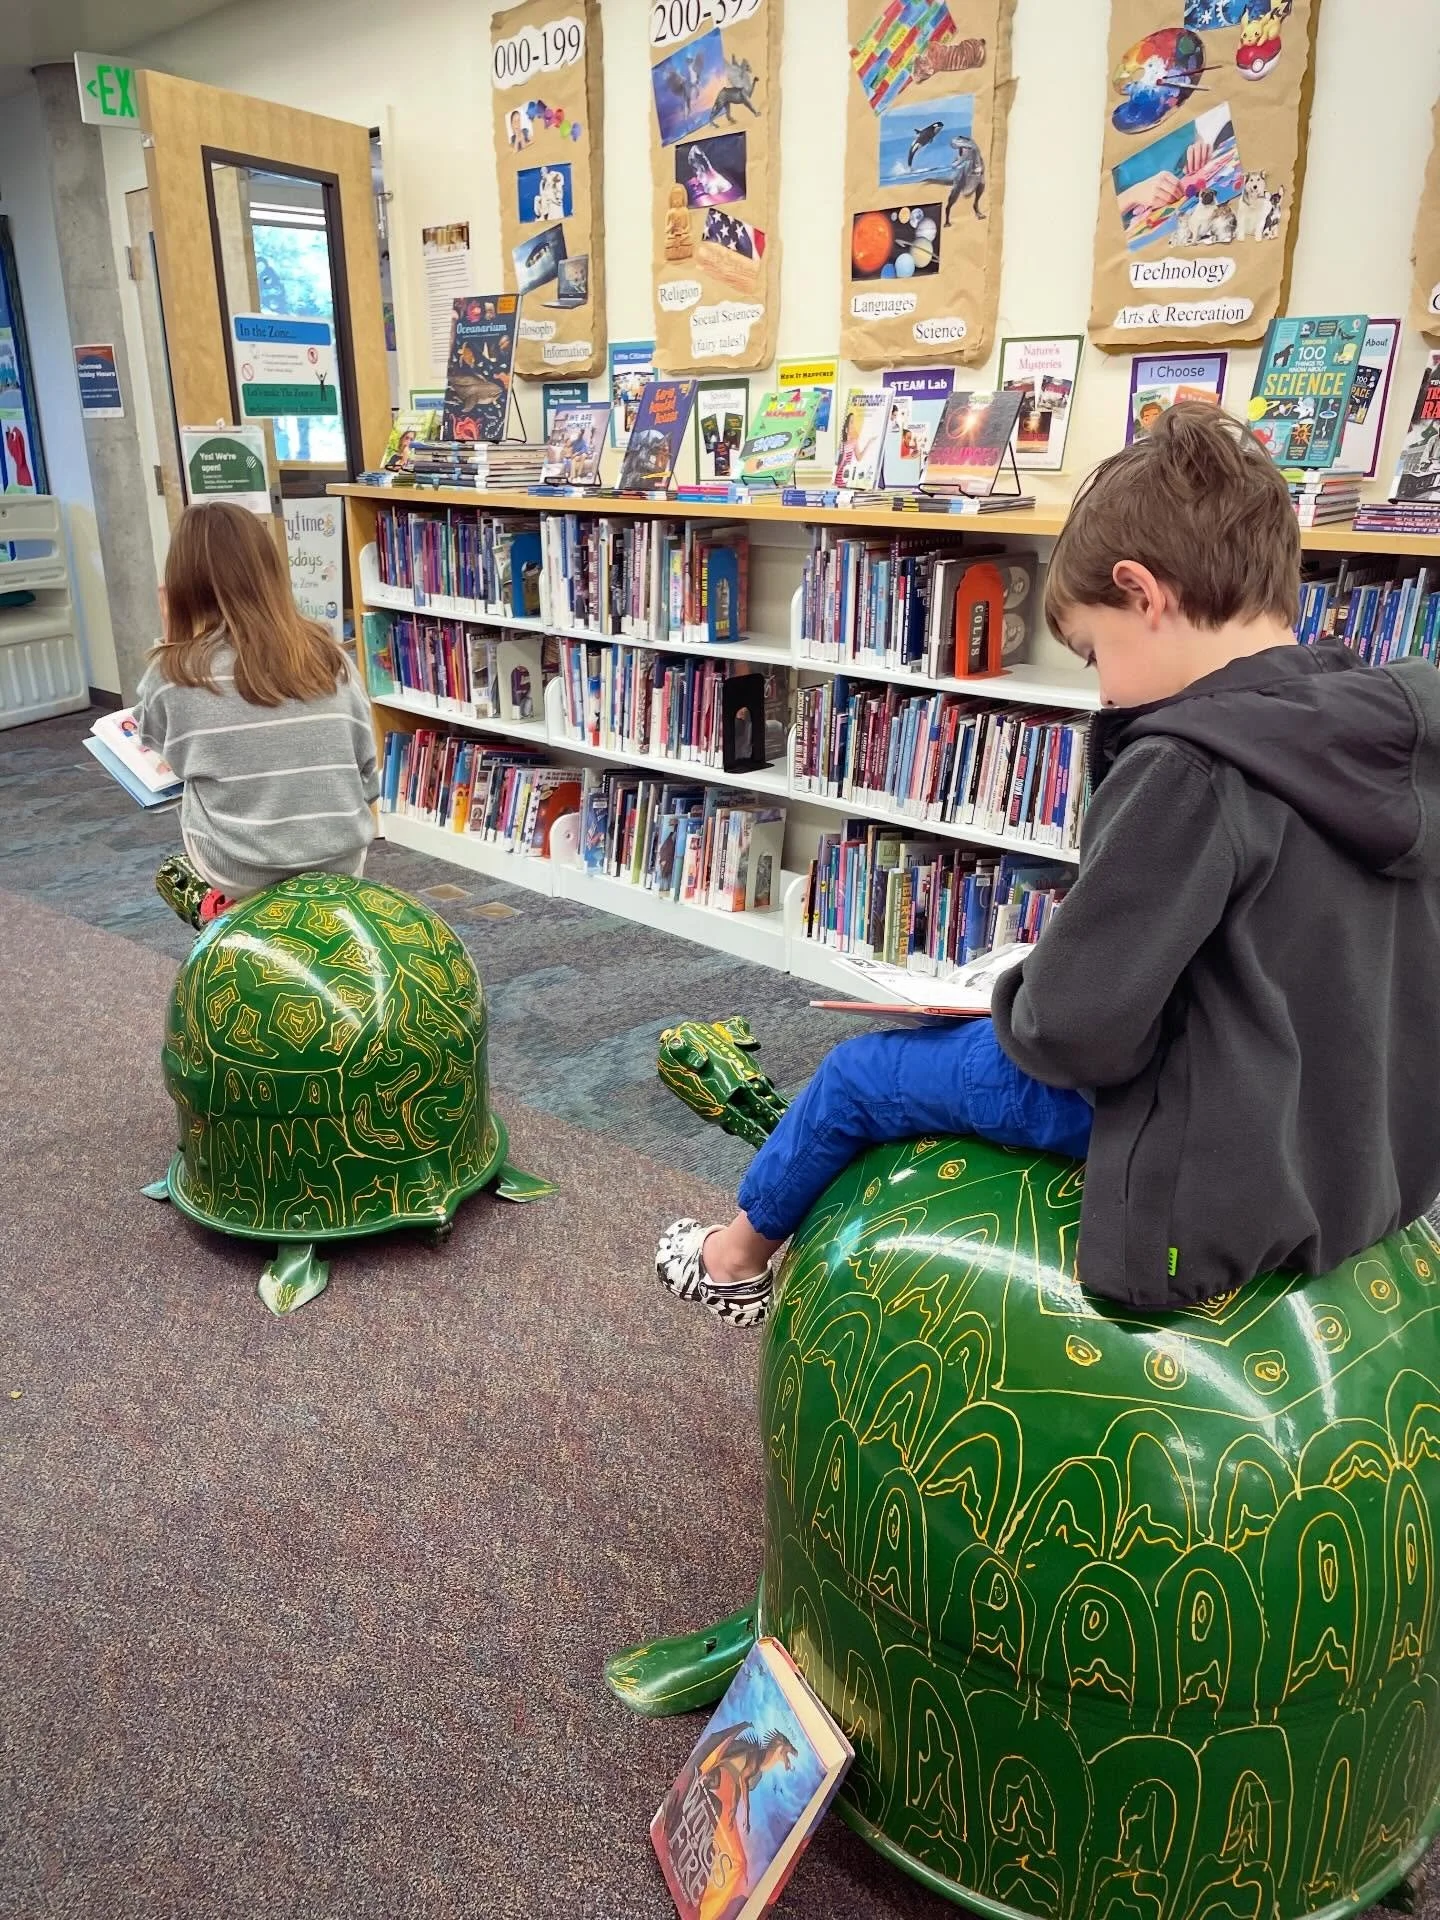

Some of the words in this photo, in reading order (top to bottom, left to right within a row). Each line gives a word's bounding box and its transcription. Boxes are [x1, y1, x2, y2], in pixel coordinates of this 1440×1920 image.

[654, 0, 759, 42] 200-3
[494, 25, 581, 79] 000-199
[1131, 261, 1229, 283] Technology
[659, 286, 699, 303] Religion
[853, 297, 915, 316] Languages
[1117, 308, 1144, 325] Arts
[1147, 308, 1161, 324] &
[1165, 304, 1245, 323] Recreation
[692, 311, 720, 327] Social
[722, 306, 761, 322] Sciences
[240, 323, 250, 337] In
[251, 324, 267, 338] the
[456, 323, 507, 334] Oceanarium
[915, 322, 965, 340] Science
[543, 342, 590, 359] Information
[1023, 344, 1061, 356] Nature's
[1365, 338, 1389, 347] About
[613, 352, 628, 361] Little
[1298, 346, 1327, 361] 100
[1017, 358, 1062, 371] Mysteries
[1150, 367, 1154, 378] I
[1157, 366, 1205, 378] Choose
[889, 380, 926, 391] STEAM
[928, 379, 948, 390] Lab
[1263, 372, 1347, 396] SCIENCE
[1356, 375, 1368, 383] 100
[1351, 386, 1371, 398] PACE
[286, 511, 325, 540] ytime
[288, 547, 323, 574] sdays
[971, 605, 984, 656] COLNS
[901, 873, 912, 935] LIBERTY
[683, 1766, 733, 1889] WINGS
[668, 1815, 710, 1907] FIRE
